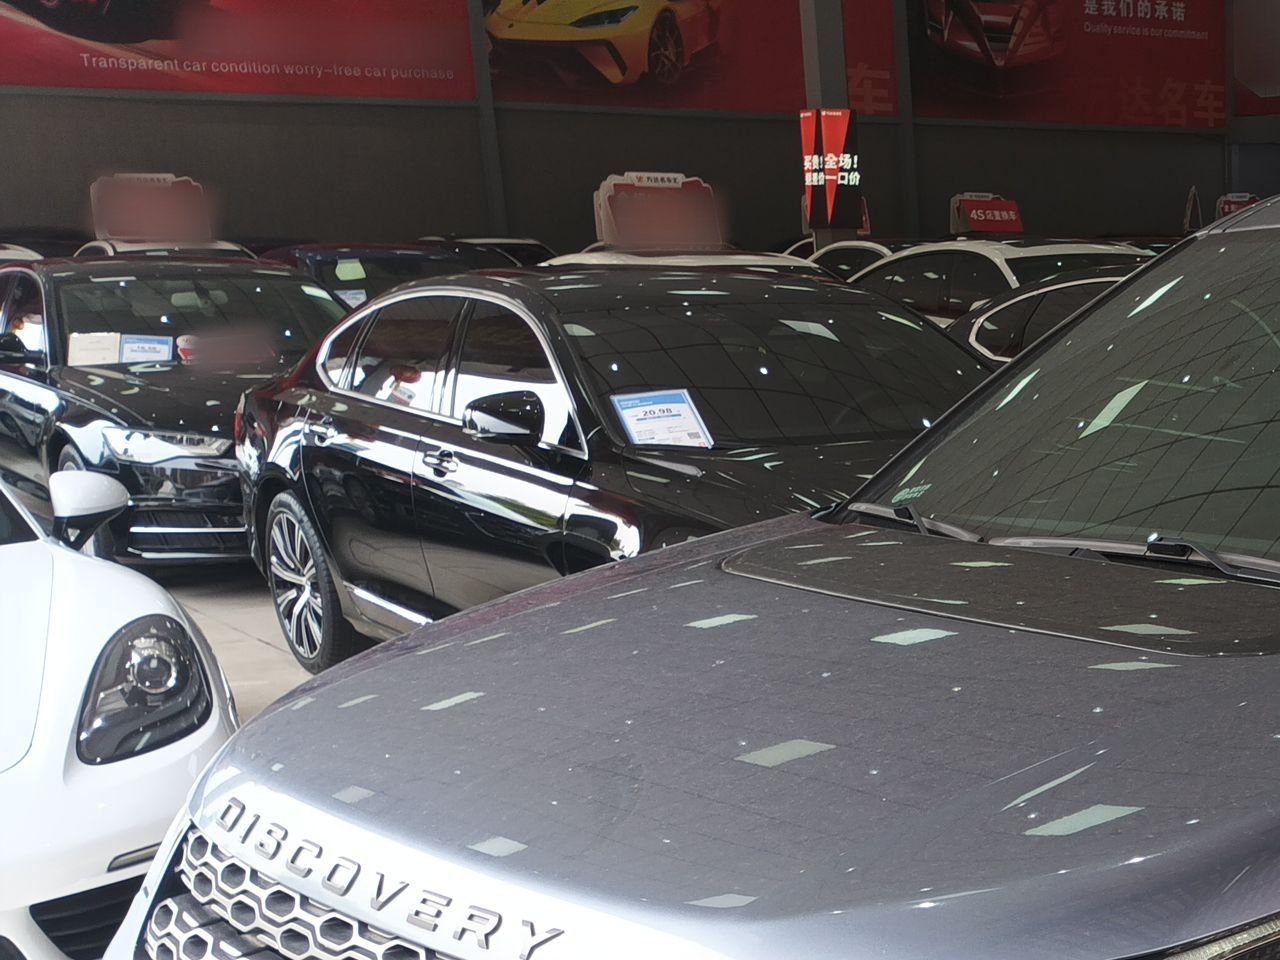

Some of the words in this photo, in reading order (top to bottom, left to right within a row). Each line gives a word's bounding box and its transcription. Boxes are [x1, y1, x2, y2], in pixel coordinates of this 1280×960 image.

[80, 53, 180, 72] Transparent
[183, 61, 207, 73] car
[211, 61, 280, 75] condition
[364, 67, 388, 78] car
[391, 68, 455, 80] purchase
[824, 153, 859, 169] 全场!
[824, 171, 861, 186] 一口价
